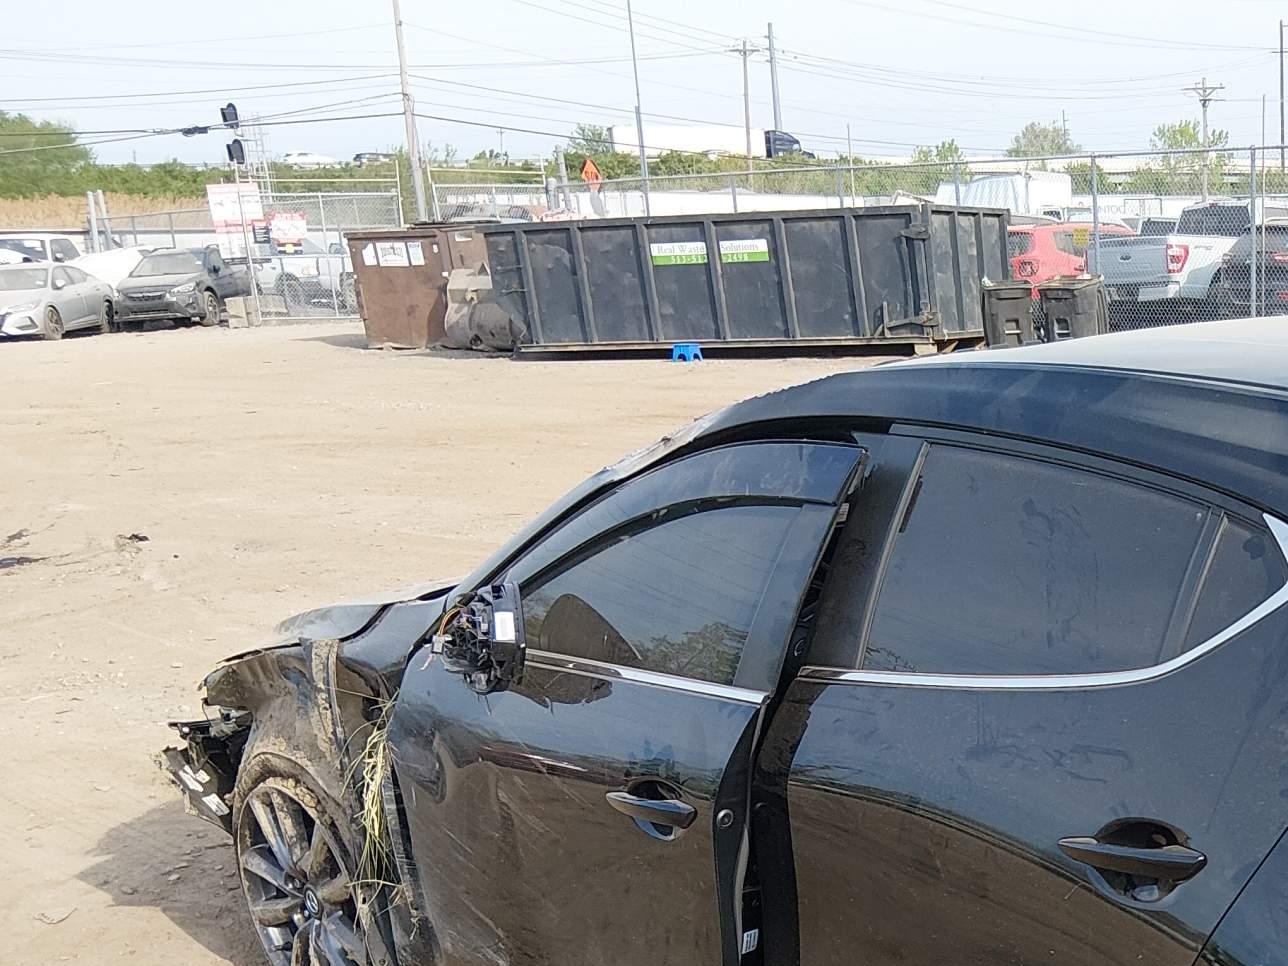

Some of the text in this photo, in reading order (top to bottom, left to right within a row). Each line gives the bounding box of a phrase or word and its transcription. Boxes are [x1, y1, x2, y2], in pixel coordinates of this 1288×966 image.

[657, 242, 759, 254] Real Waste Solutions
